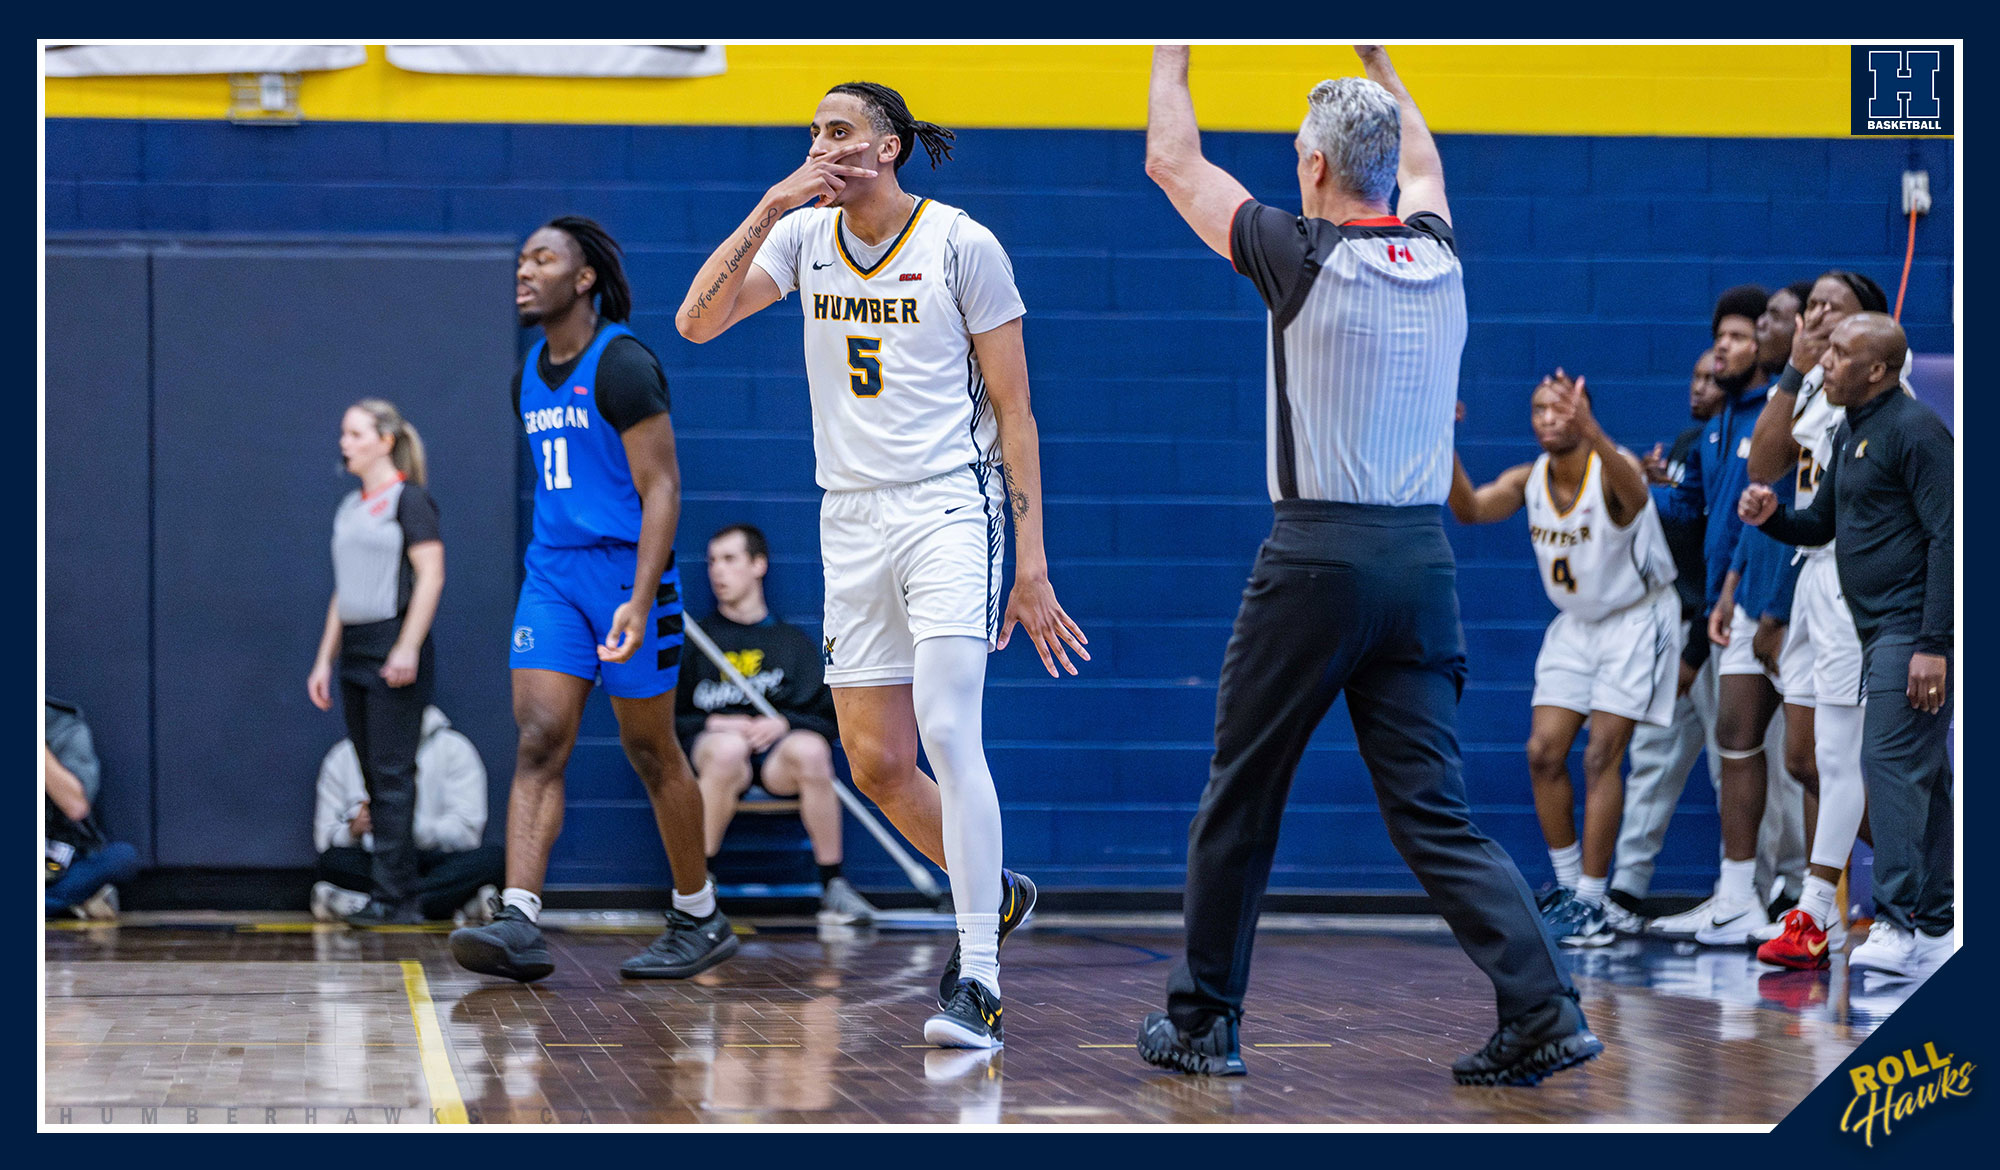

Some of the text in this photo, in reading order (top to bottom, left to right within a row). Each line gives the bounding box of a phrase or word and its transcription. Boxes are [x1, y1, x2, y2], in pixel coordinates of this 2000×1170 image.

[698, 272, 728, 309] Forever
[725, 237, 753, 273] Locked
[813, 293, 921, 324] HUMBER
[845, 335, 884, 398] 5
[1551, 556, 1577, 594] 4
